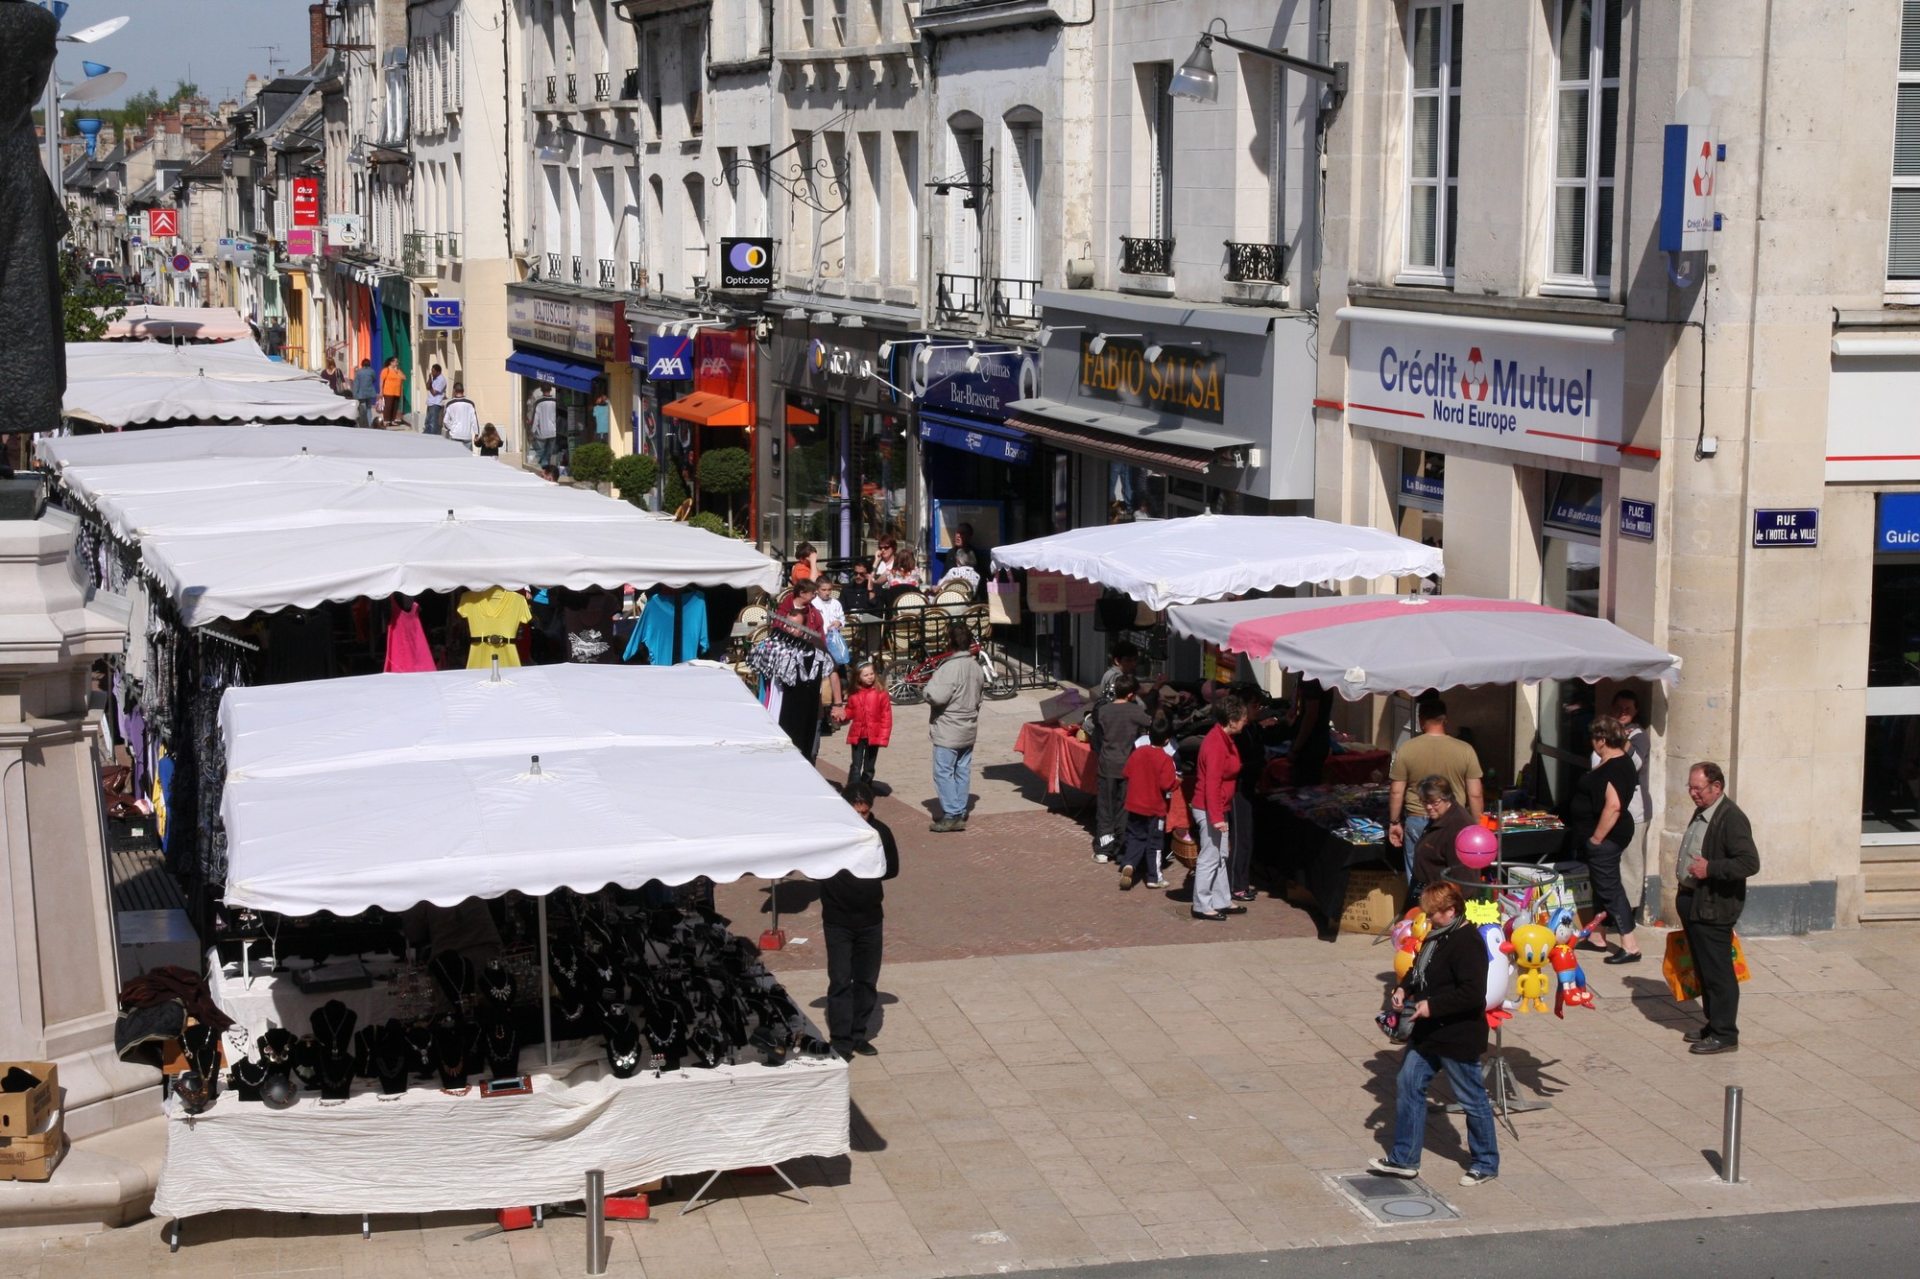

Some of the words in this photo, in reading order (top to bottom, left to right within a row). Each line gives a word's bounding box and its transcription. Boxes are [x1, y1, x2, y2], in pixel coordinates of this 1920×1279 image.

[329, 217, 359, 225] PRESSING
[725, 276, 748, 286] Optic
[429, 306, 456, 315] LCL
[649, 357, 685, 375] AXA
[701, 357, 731, 375] AXA
[1082, 341, 1144, 396] FABIO
[1149, 355, 1221, 411] SALSA
[1379, 346, 1457, 400] Crédit
[1492, 359, 1592, 417] Mutuel
[951, 382, 1000, 410] Bar-Brasserie
[1433, 400, 1464, 424] Nord
[1468, 404, 1517, 434] Europe
[1406, 480, 1414, 489] La
[1557, 506, 1567, 517] La
[1628, 505, 1645, 518] PLACE
[1776, 515, 1797, 526] RUE
[1756, 529, 1763, 540] de
[1790, 529, 1798, 540] de
[1800, 528, 1816, 540] VILLE
[1886, 530, 1919, 543] Guic
